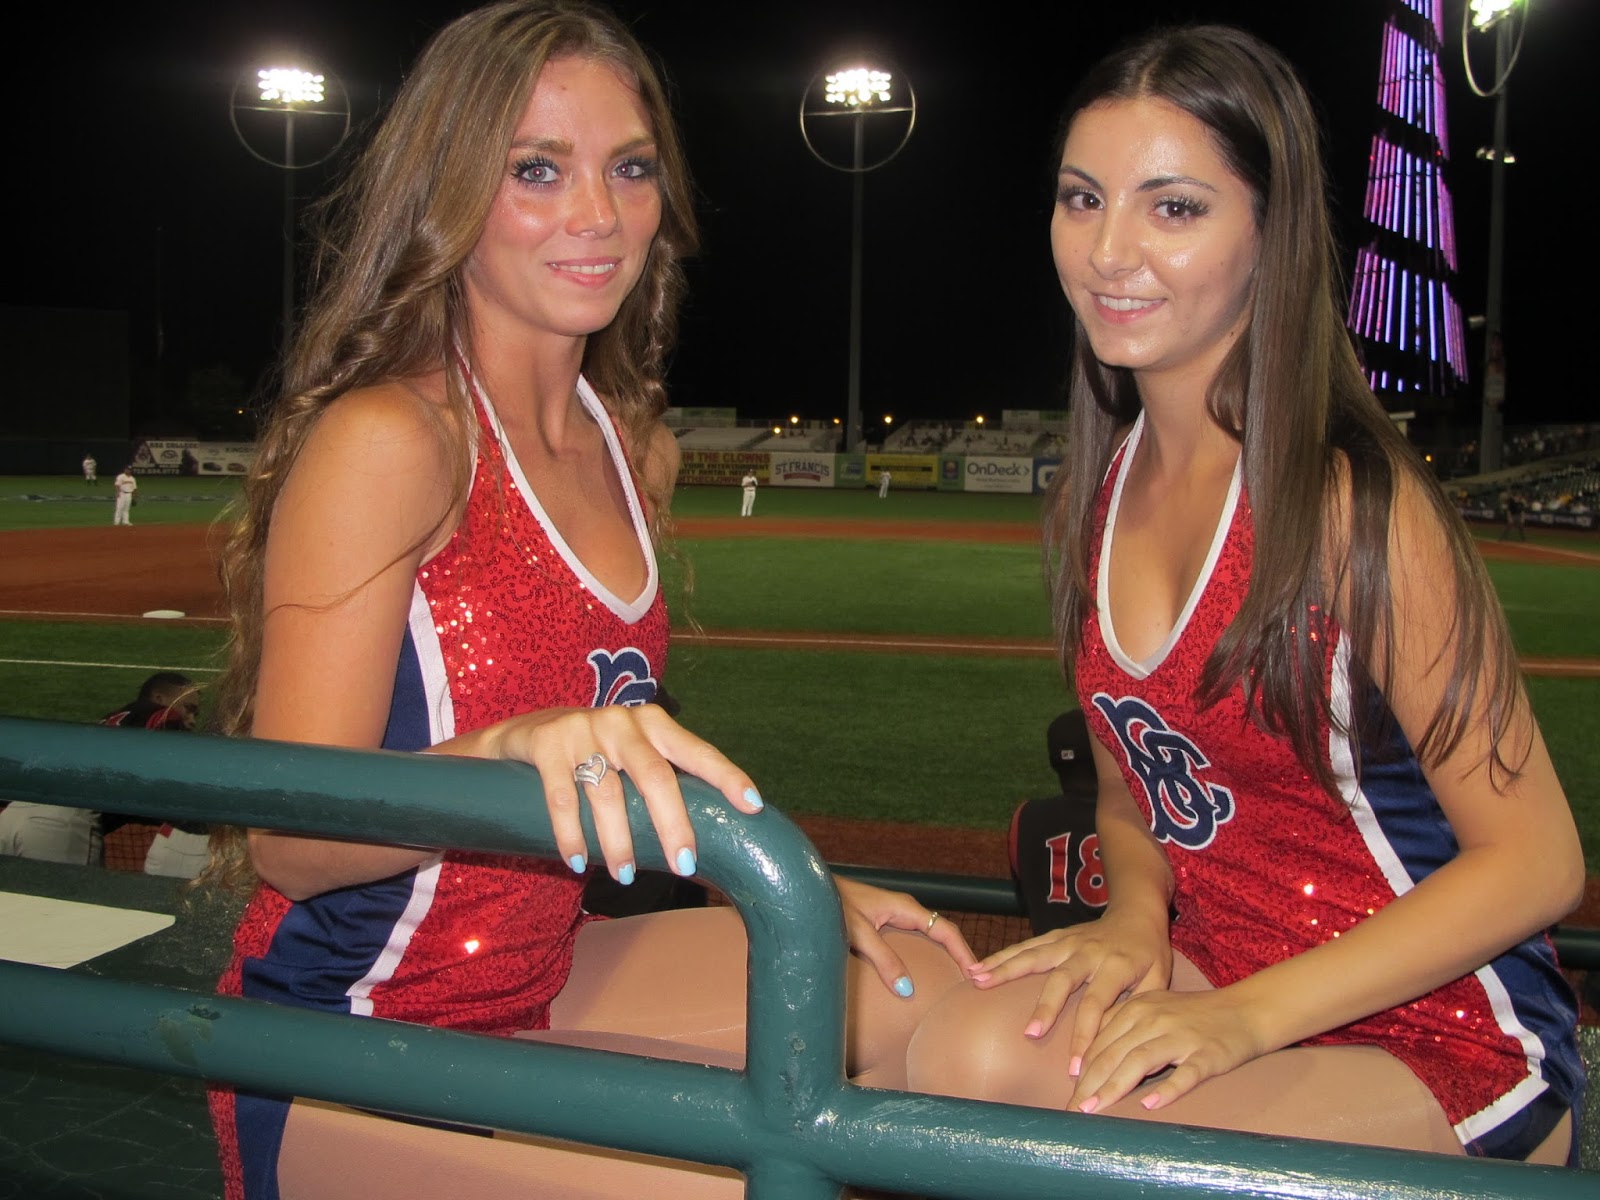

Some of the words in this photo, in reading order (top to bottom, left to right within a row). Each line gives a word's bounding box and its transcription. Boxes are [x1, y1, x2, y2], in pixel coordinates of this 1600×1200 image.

[697, 452, 720, 463] THE
[722, 452, 770, 464] CLOWNS
[967, 462, 1021, 476] OnDeck
[1045, 831, 1110, 907] 18
